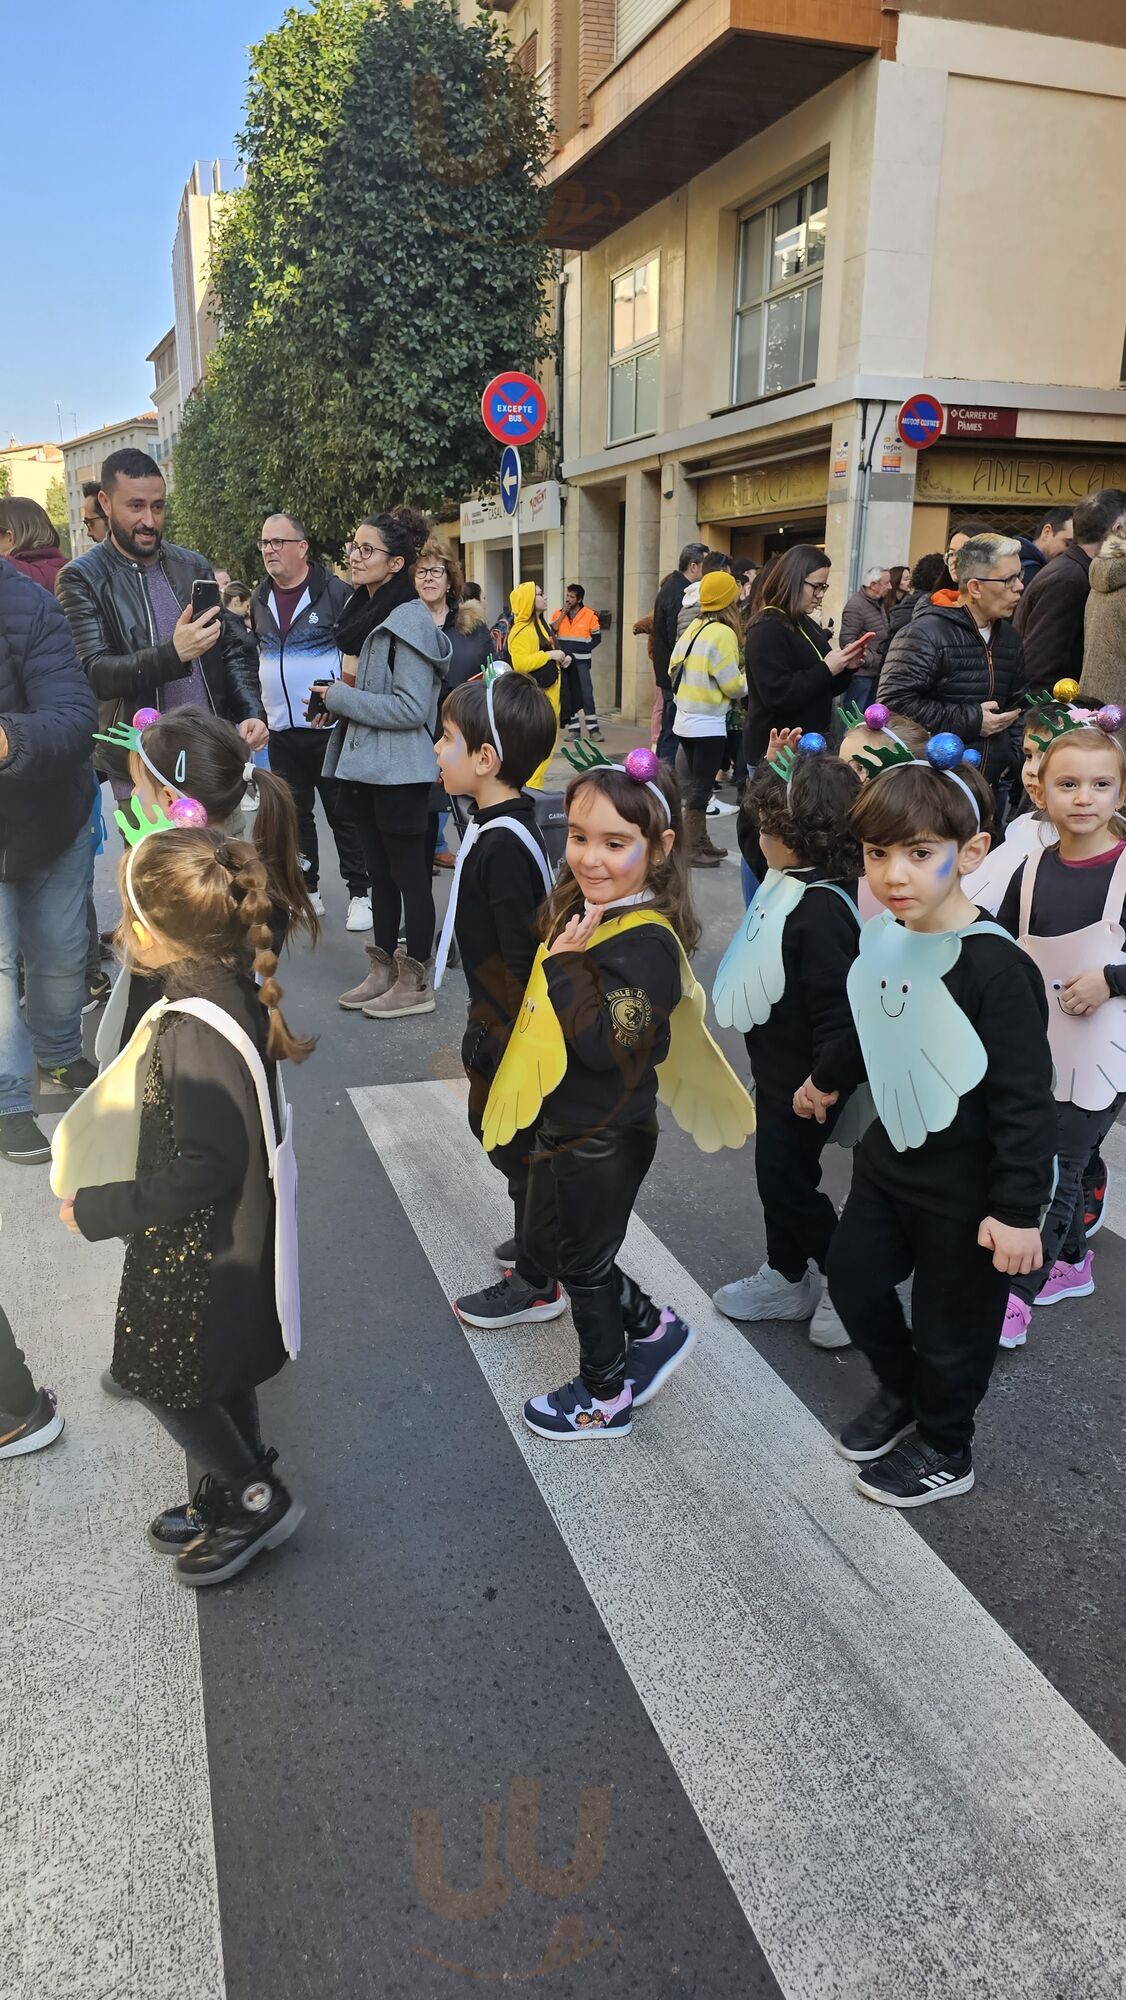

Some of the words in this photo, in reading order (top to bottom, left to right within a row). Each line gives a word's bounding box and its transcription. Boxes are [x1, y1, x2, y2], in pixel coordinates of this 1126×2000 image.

[497, 405, 533, 413] EXCEPTE
[959, 409, 987, 420] CARRER
[988, 412, 998, 420] DE
[508, 414, 522, 422] BUS
[957, 420, 982, 431] PÀMIES
[973, 457, 1106, 496] AMERICA
